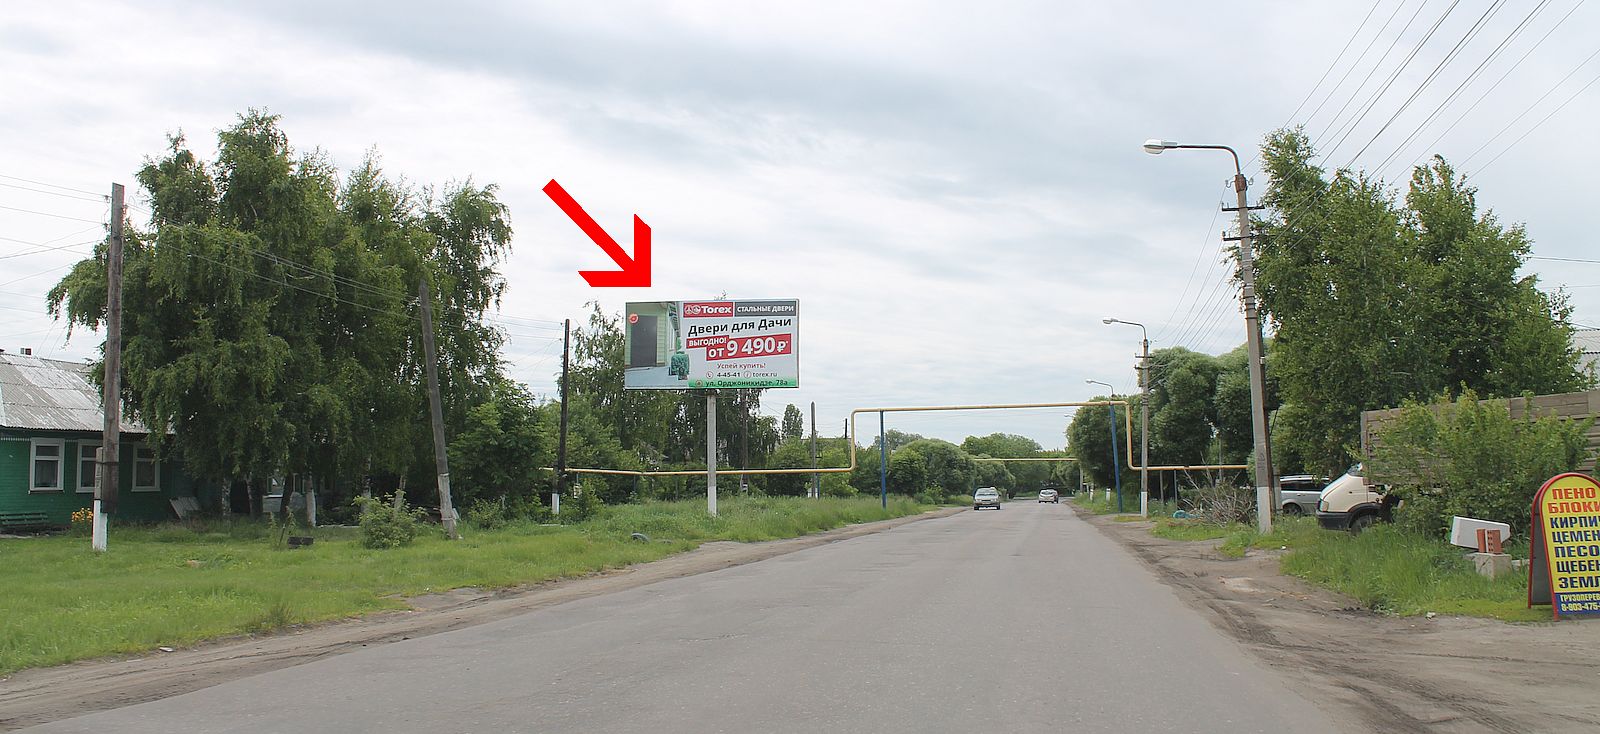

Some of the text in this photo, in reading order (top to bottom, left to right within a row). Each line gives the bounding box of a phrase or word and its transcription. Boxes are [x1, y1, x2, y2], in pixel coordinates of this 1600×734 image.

[701, 305, 732, 314] Torex
[737, 305, 794, 313] СТАЛЬНЫЕ ДВЕРИ
[688, 318, 792, 337] Двери для Дачи
[688, 337, 727, 347] ВЫГОДНО!
[726, 340, 738, 357] 9
[716, 362, 738, 370] Успей
[1552, 488, 1596, 499] ПЕНО
[1548, 502, 1600, 513] БЛОКИ
[1550, 516, 1600, 528] КИРПИ
[1552, 530, 1600, 544] ЦЕМЕН
[1554, 545, 1600, 557] ПЕСО
